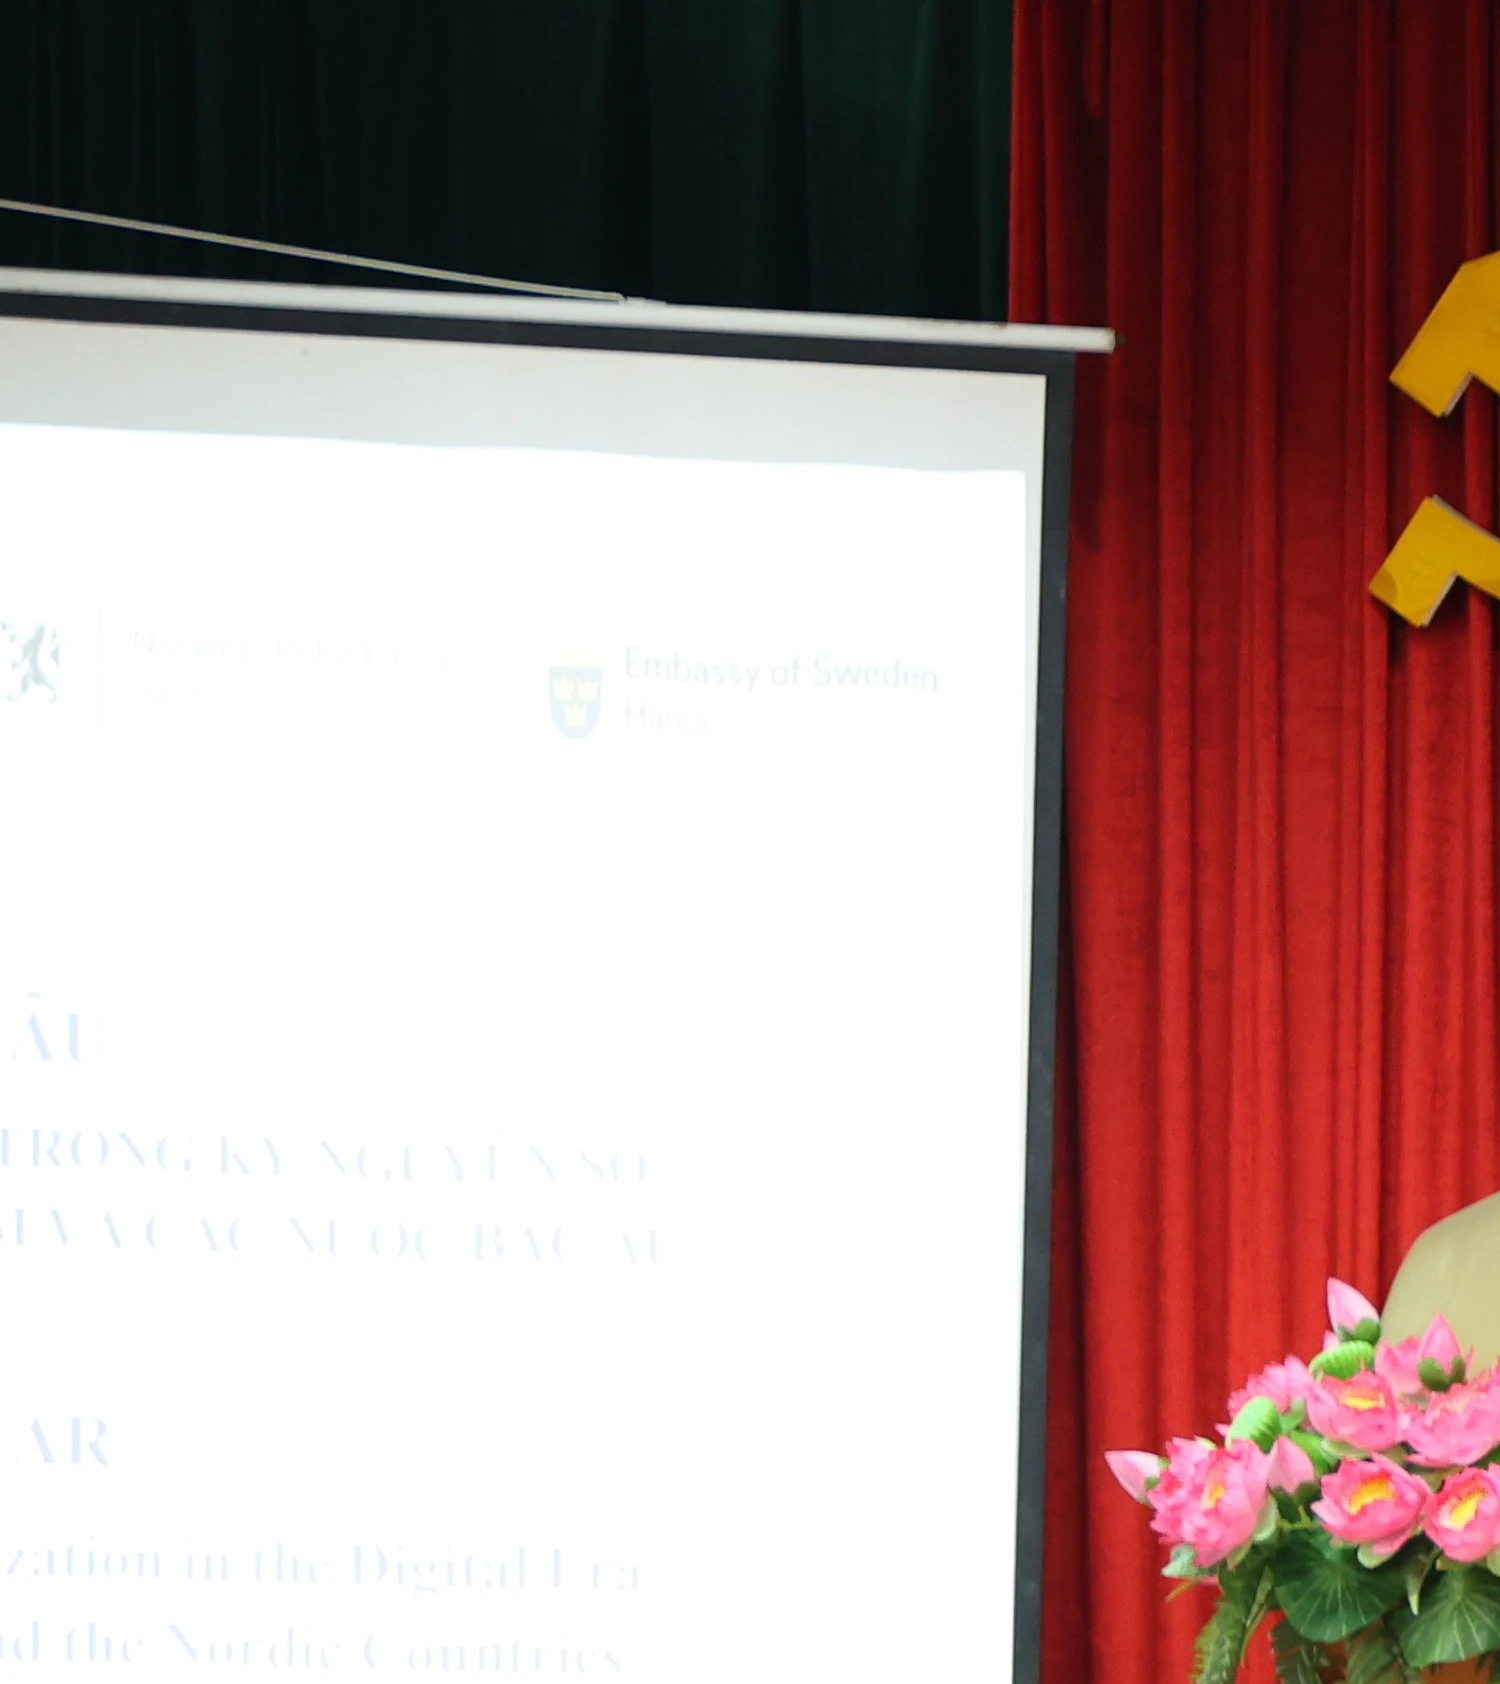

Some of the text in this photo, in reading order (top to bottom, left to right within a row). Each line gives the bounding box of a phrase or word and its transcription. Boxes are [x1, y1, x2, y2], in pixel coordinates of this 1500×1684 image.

[623, 644, 942, 694] Embassy of Sweden
[253, 1540, 331, 1584] the
[353, 1542, 528, 1597] Digital
[64, 1620, 144, 1665] the
[166, 1622, 342, 1672] Nordic
